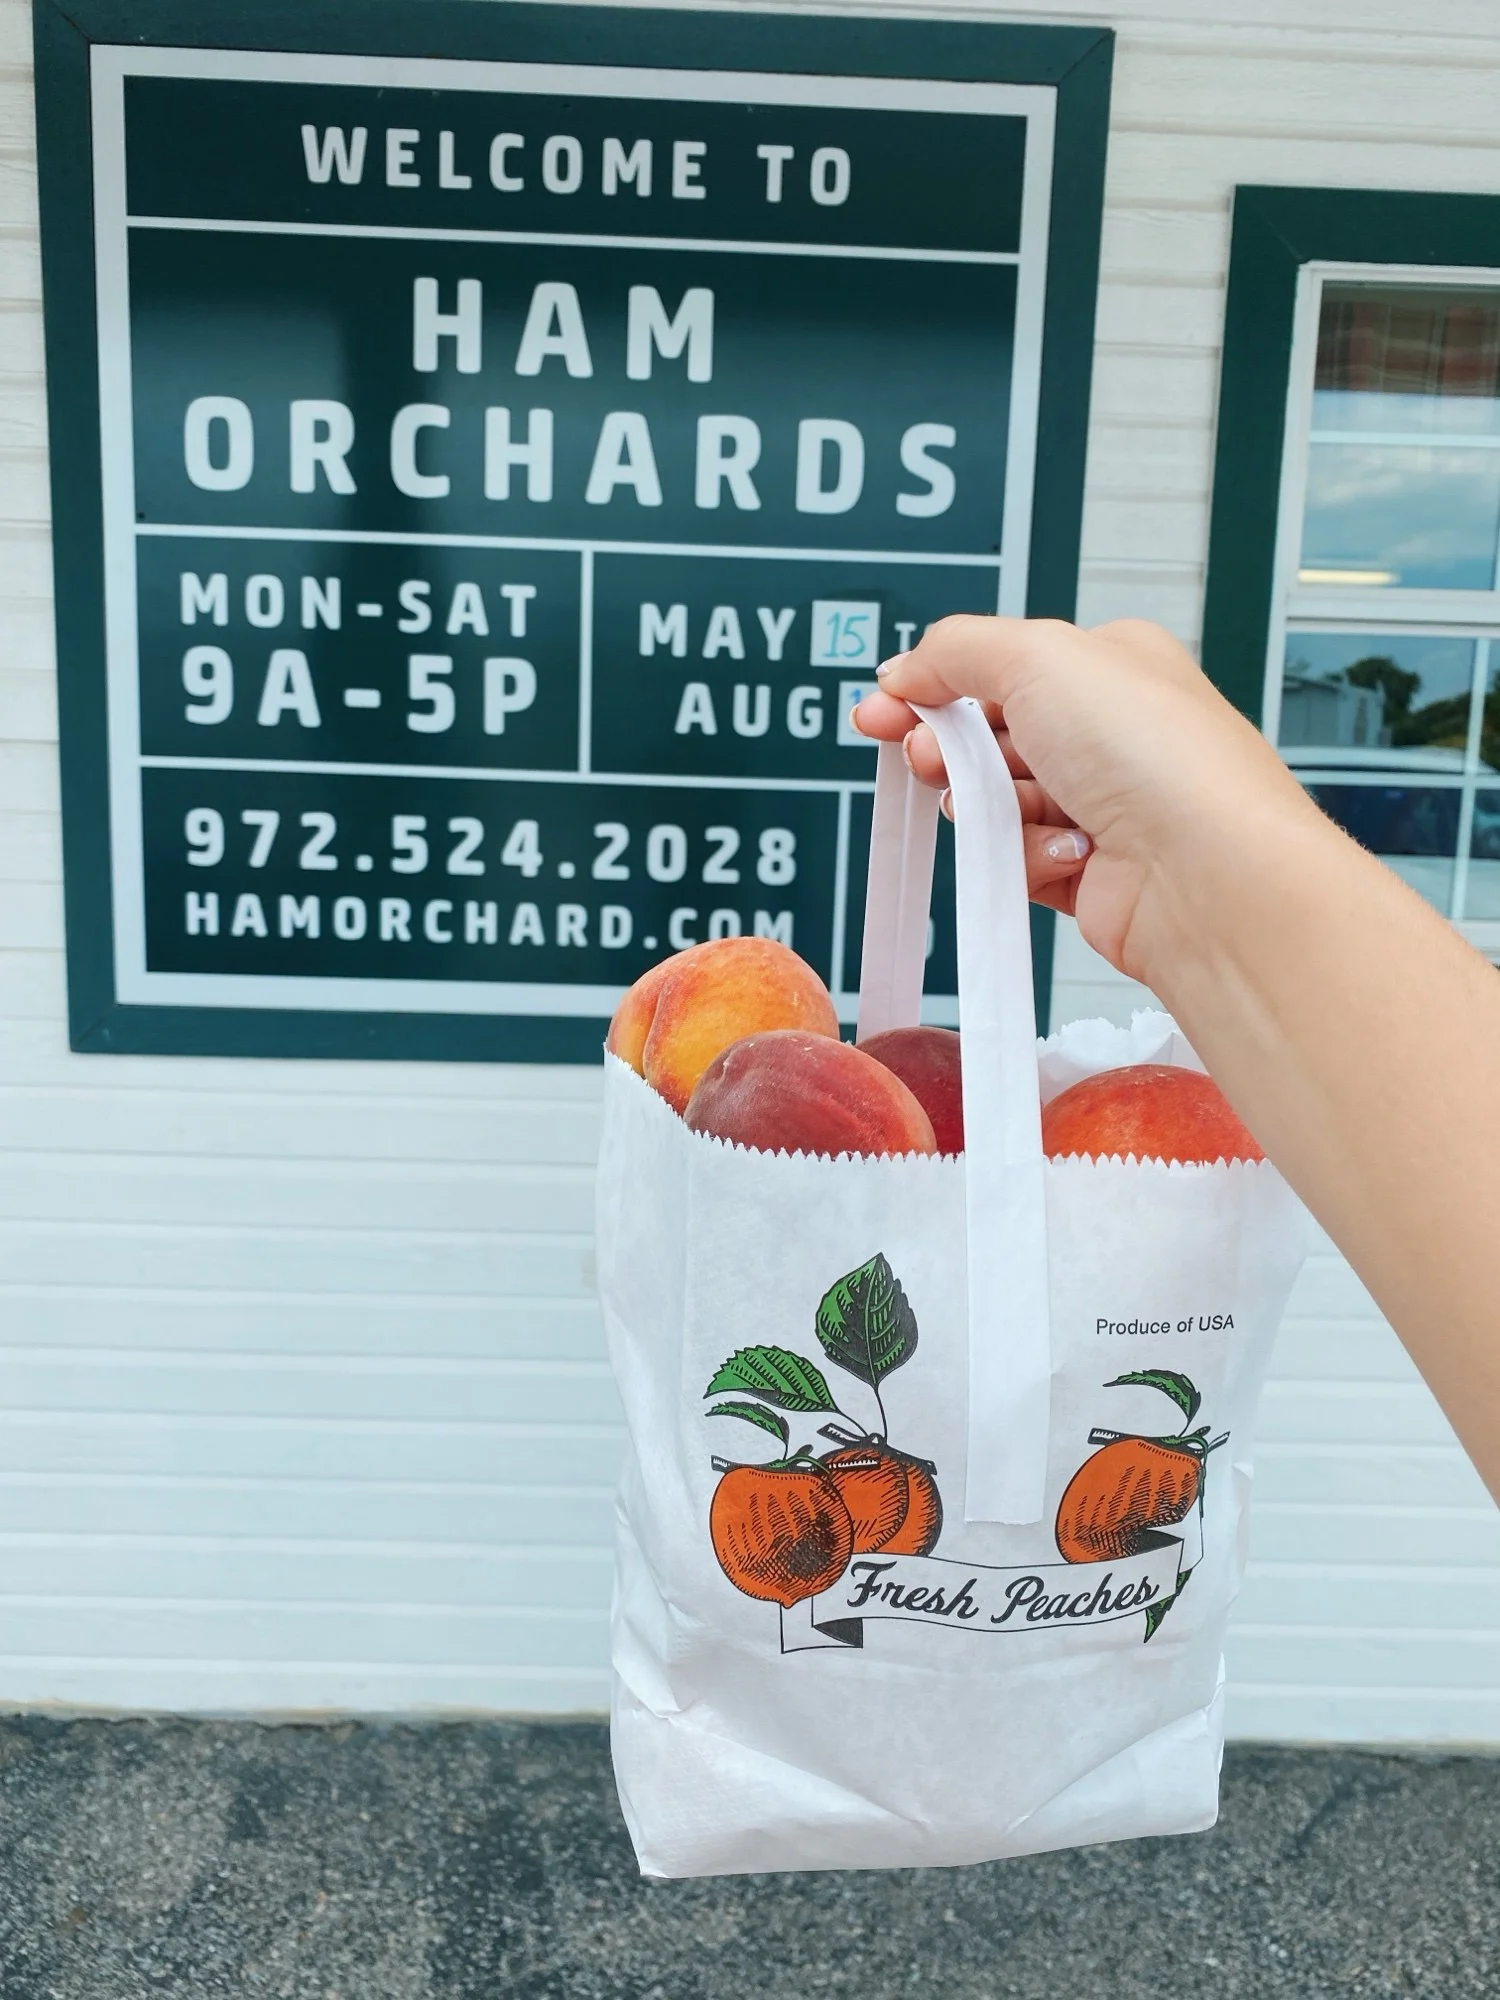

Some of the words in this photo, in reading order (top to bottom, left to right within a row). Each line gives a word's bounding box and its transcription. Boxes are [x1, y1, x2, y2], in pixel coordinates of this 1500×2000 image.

[301, 124, 707, 199] WELCOME
[757, 144, 851, 206] TO
[413, 277, 714, 383] HAM
[184, 396, 957, 518] ORCHARDS
[180, 572, 538, 638] MON-SAT
[639, 603, 796, 661] MAY
[823, 612, 870, 658] 15
[182, 645, 538, 735] 9A-5P
[674, 682, 824, 739] AUG
[184, 808, 797, 886] 972.524.2028
[185, 891, 794, 951] HAMORCHARD.COM
[1096, 1318, 1171, 1335] Produce
[1176, 1317, 1195, 1333] of
[1199, 1313, 1235, 1332] USA
[847, 1561, 980, 1619] Fresh
[991, 1572, 1160, 1624] Peaches
